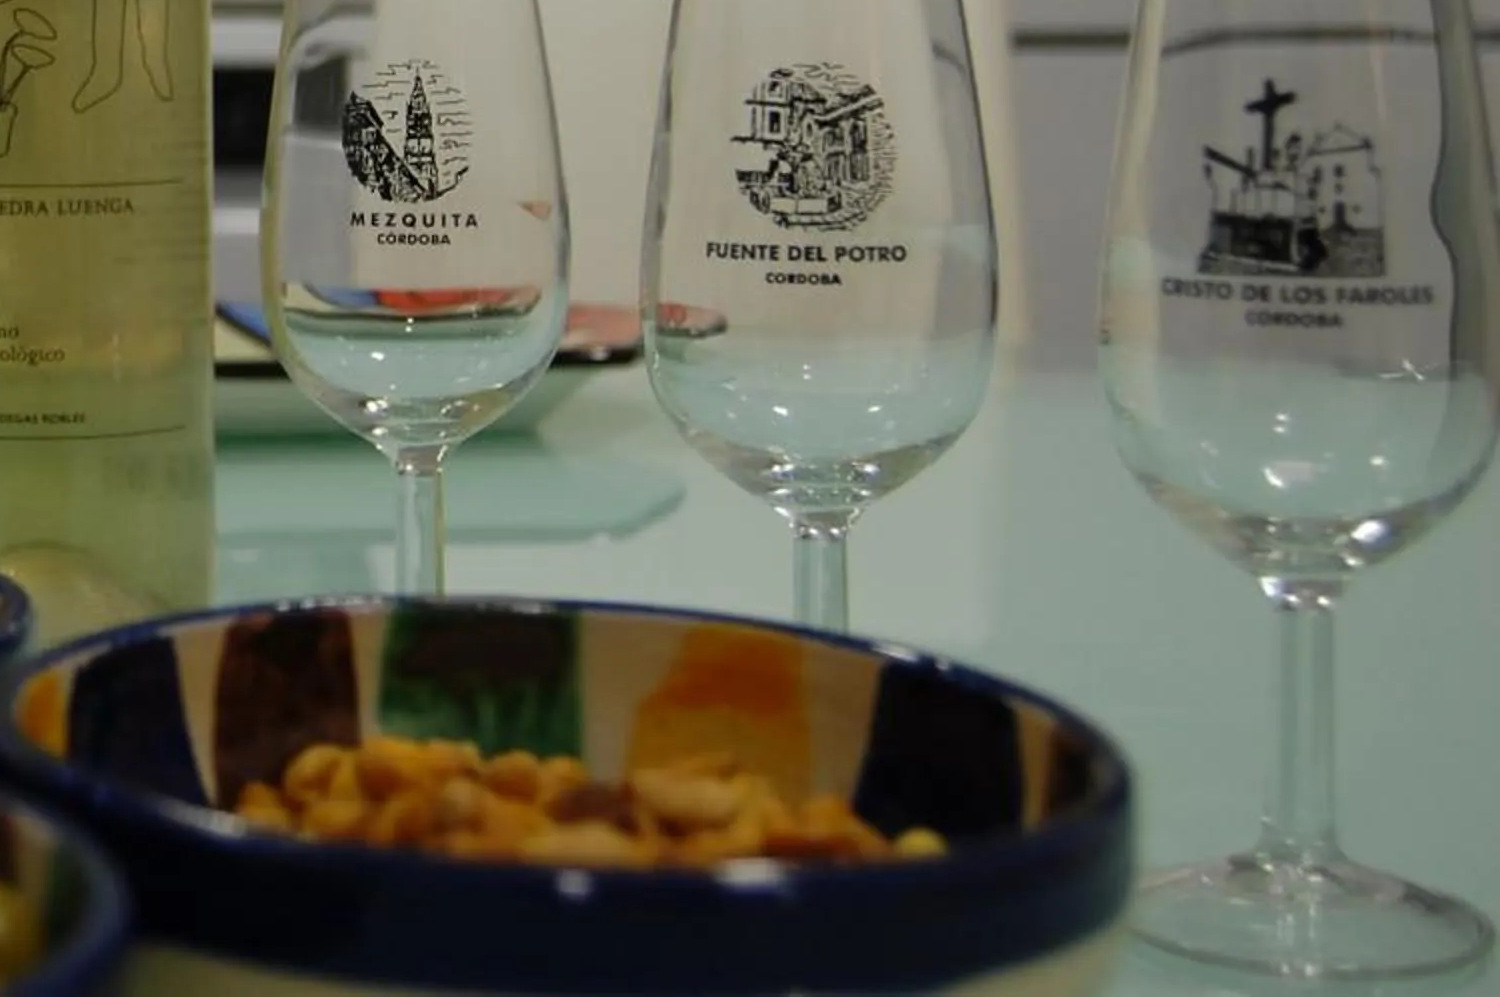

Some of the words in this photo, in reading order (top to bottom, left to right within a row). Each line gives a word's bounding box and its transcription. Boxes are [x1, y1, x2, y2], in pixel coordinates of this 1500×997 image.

[57, 198, 134, 215] LUENGA
[350, 211, 478, 229] MEZQUITA
[706, 242, 779, 260] FUENTE
[787, 245, 827, 261] DEL
[835, 245, 907, 262] POTRO
[1161, 277, 1234, 300] CRISTO
[1241, 284, 1271, 301] DE
[1279, 285, 1327, 304] LOS
